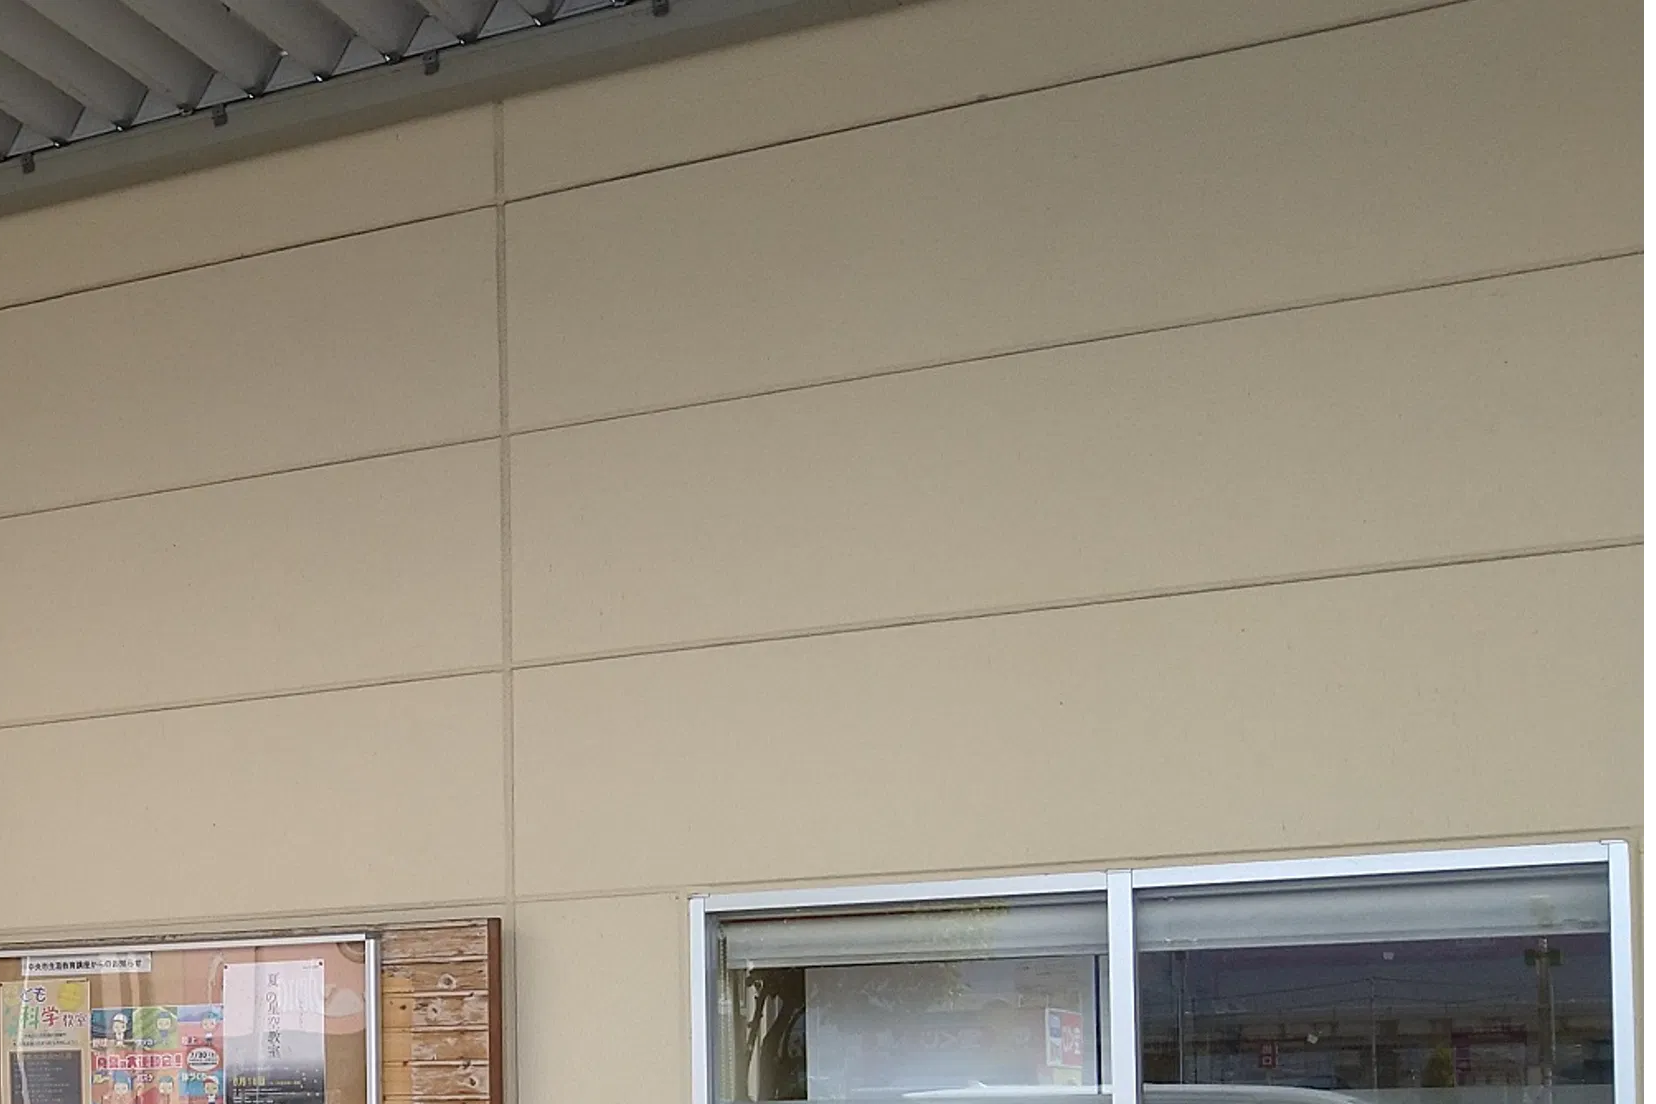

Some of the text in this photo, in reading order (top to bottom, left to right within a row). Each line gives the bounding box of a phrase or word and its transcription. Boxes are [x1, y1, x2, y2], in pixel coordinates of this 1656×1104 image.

[265, 972, 281, 1059] 夏の星空教室
